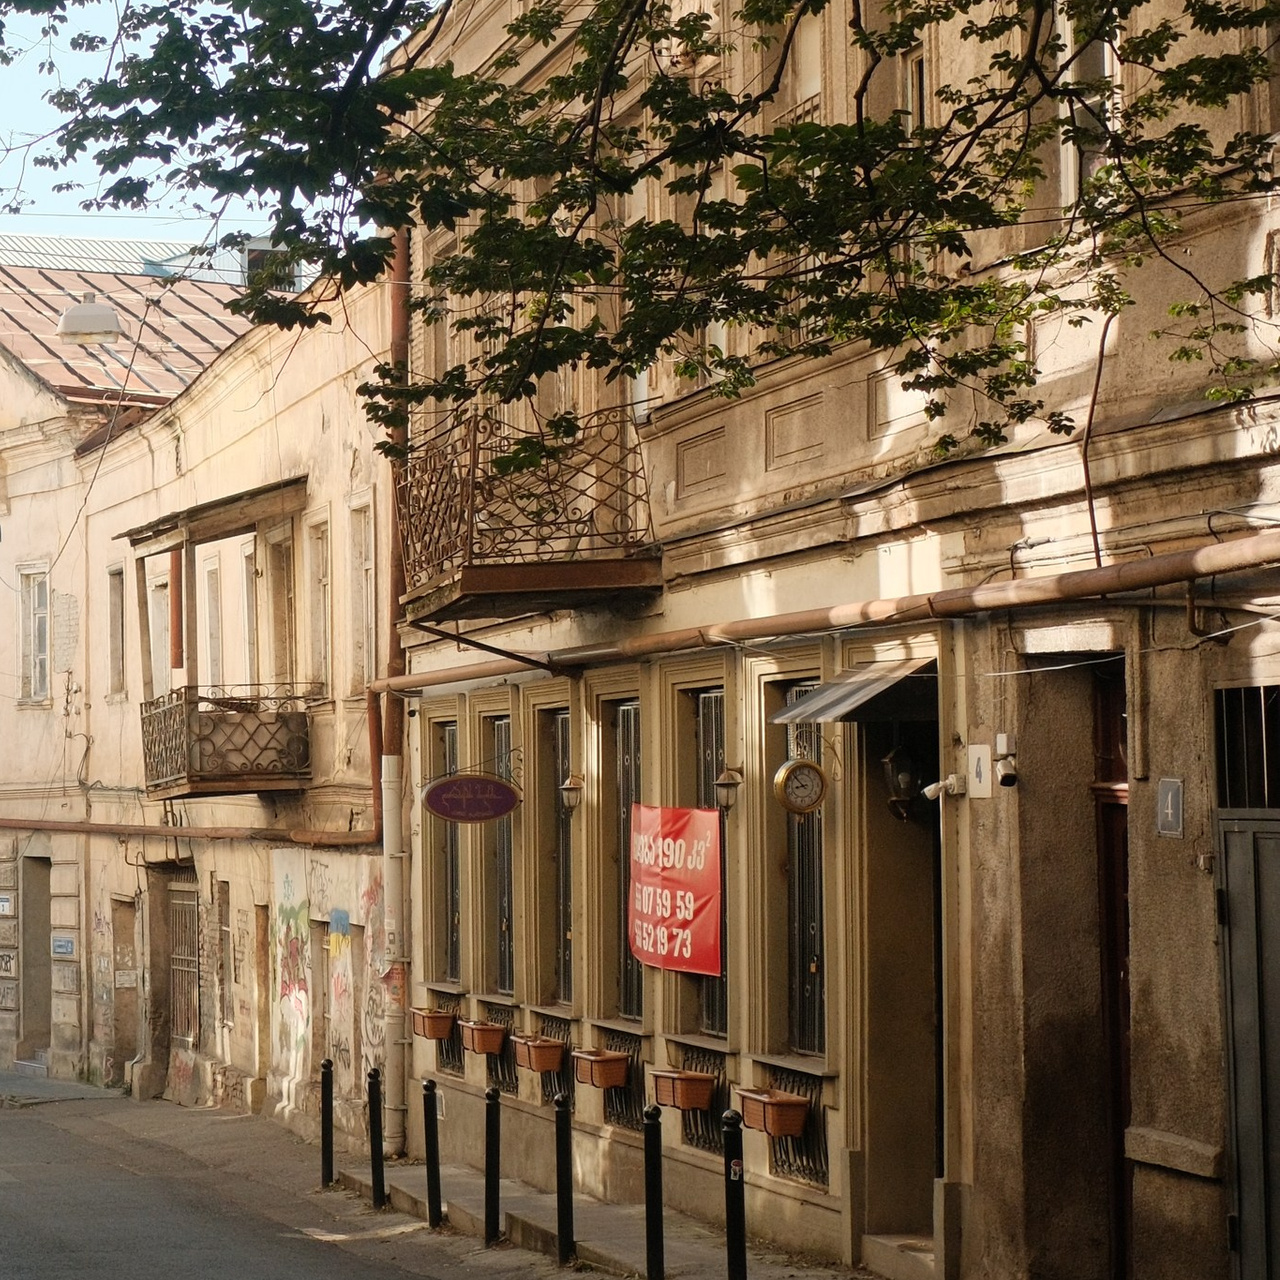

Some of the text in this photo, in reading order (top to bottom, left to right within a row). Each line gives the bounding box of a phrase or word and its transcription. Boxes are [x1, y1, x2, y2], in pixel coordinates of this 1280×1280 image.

[975, 756, 983, 784] 4
[1164, 791, 1173, 821] 4
[658, 837, 686, 869] 190
[656, 888, 671, 919] 59
[676, 890, 695, 921] 59
[642, 921, 654, 953] 52
[656, 924, 668, 956] 19
[672, 928, 692, 959] 73
